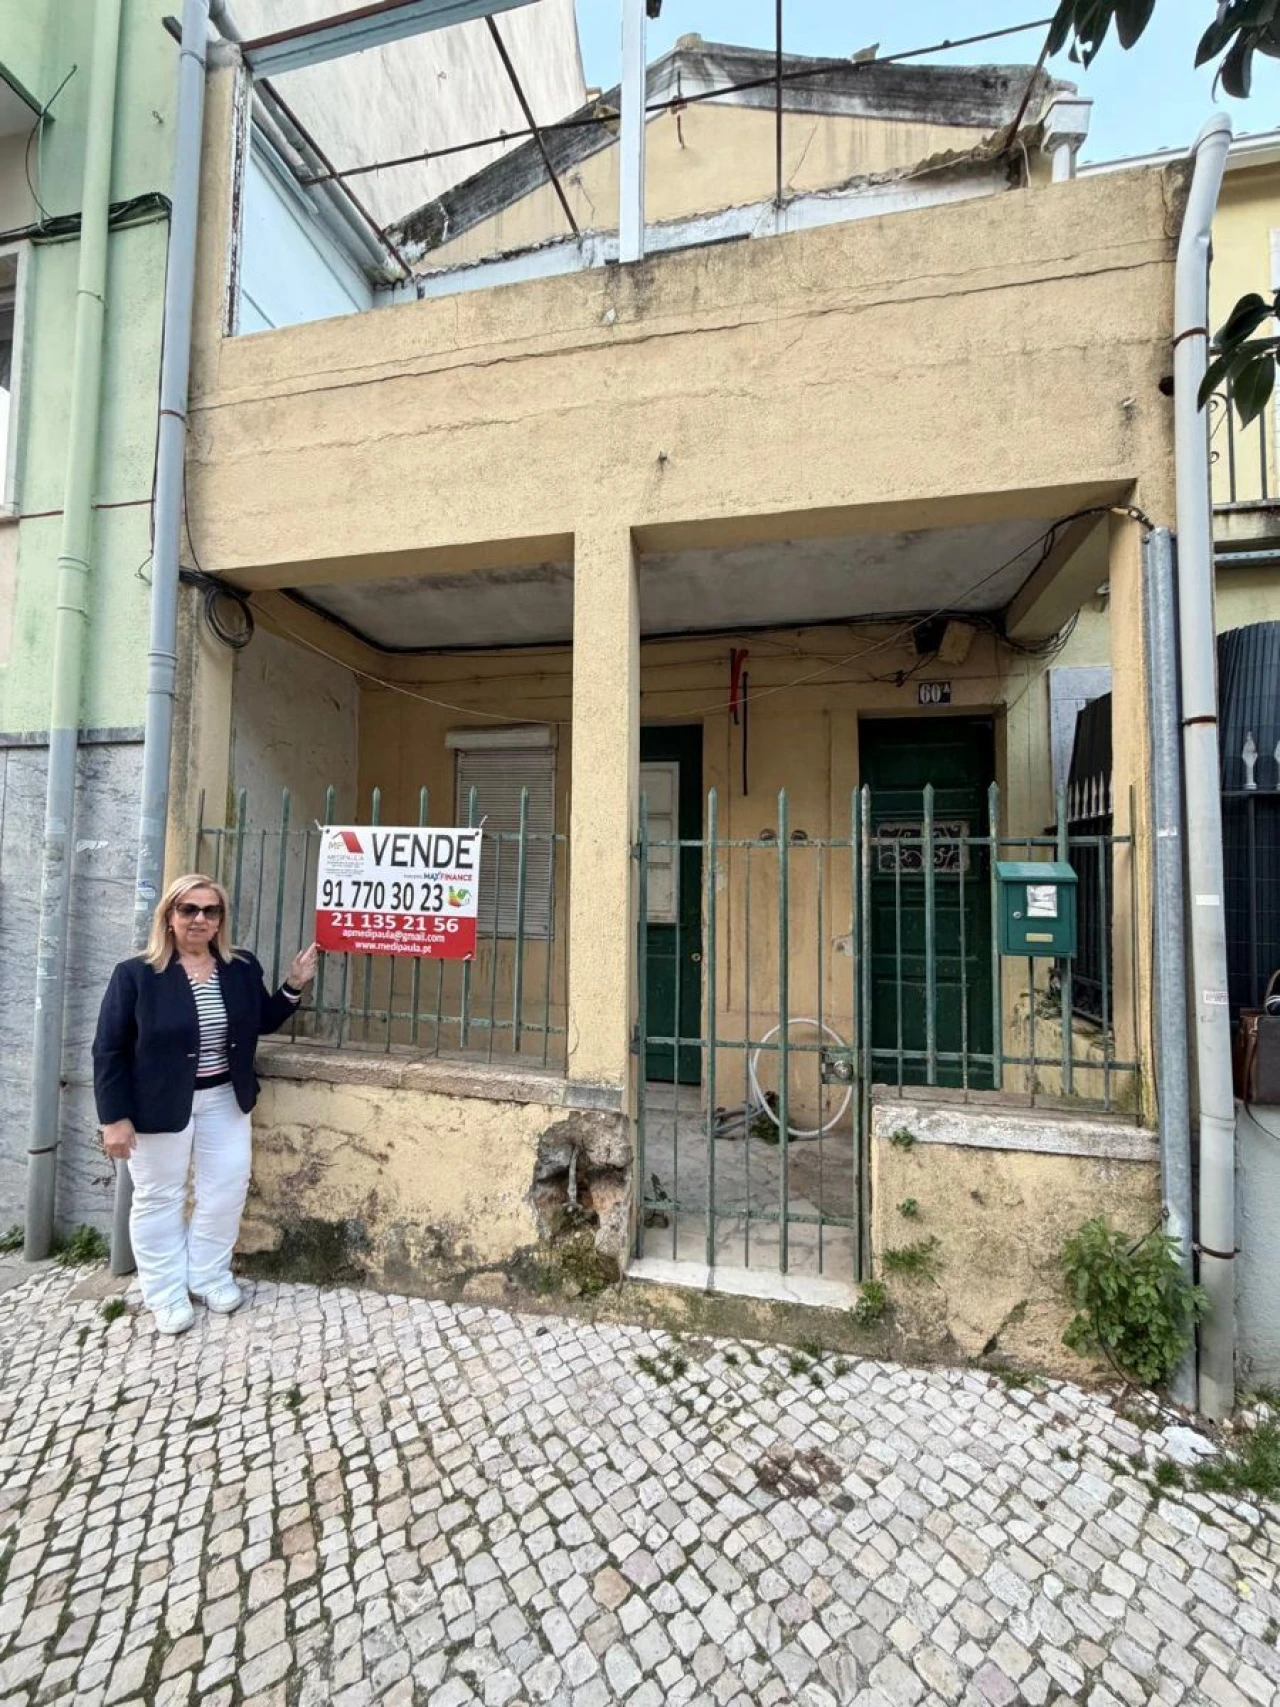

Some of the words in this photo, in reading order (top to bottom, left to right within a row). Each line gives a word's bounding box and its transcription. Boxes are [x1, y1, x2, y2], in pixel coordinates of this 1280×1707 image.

[371, 833, 476, 869] VENDE
[322, 879, 344, 907] 91
[351, 881, 385, 910] 770
[390, 881, 415, 911] 30
[420, 883, 443, 912] 23
[331, 912, 354, 927] 21
[360, 914, 396, 929] 135
[402, 916, 427, 931] 21
[433, 917, 459, 933] 56
[342, 929, 445, 943] apmedipaula@gmail.com
[355, 942, 432, 954] www.medipaula.pt
